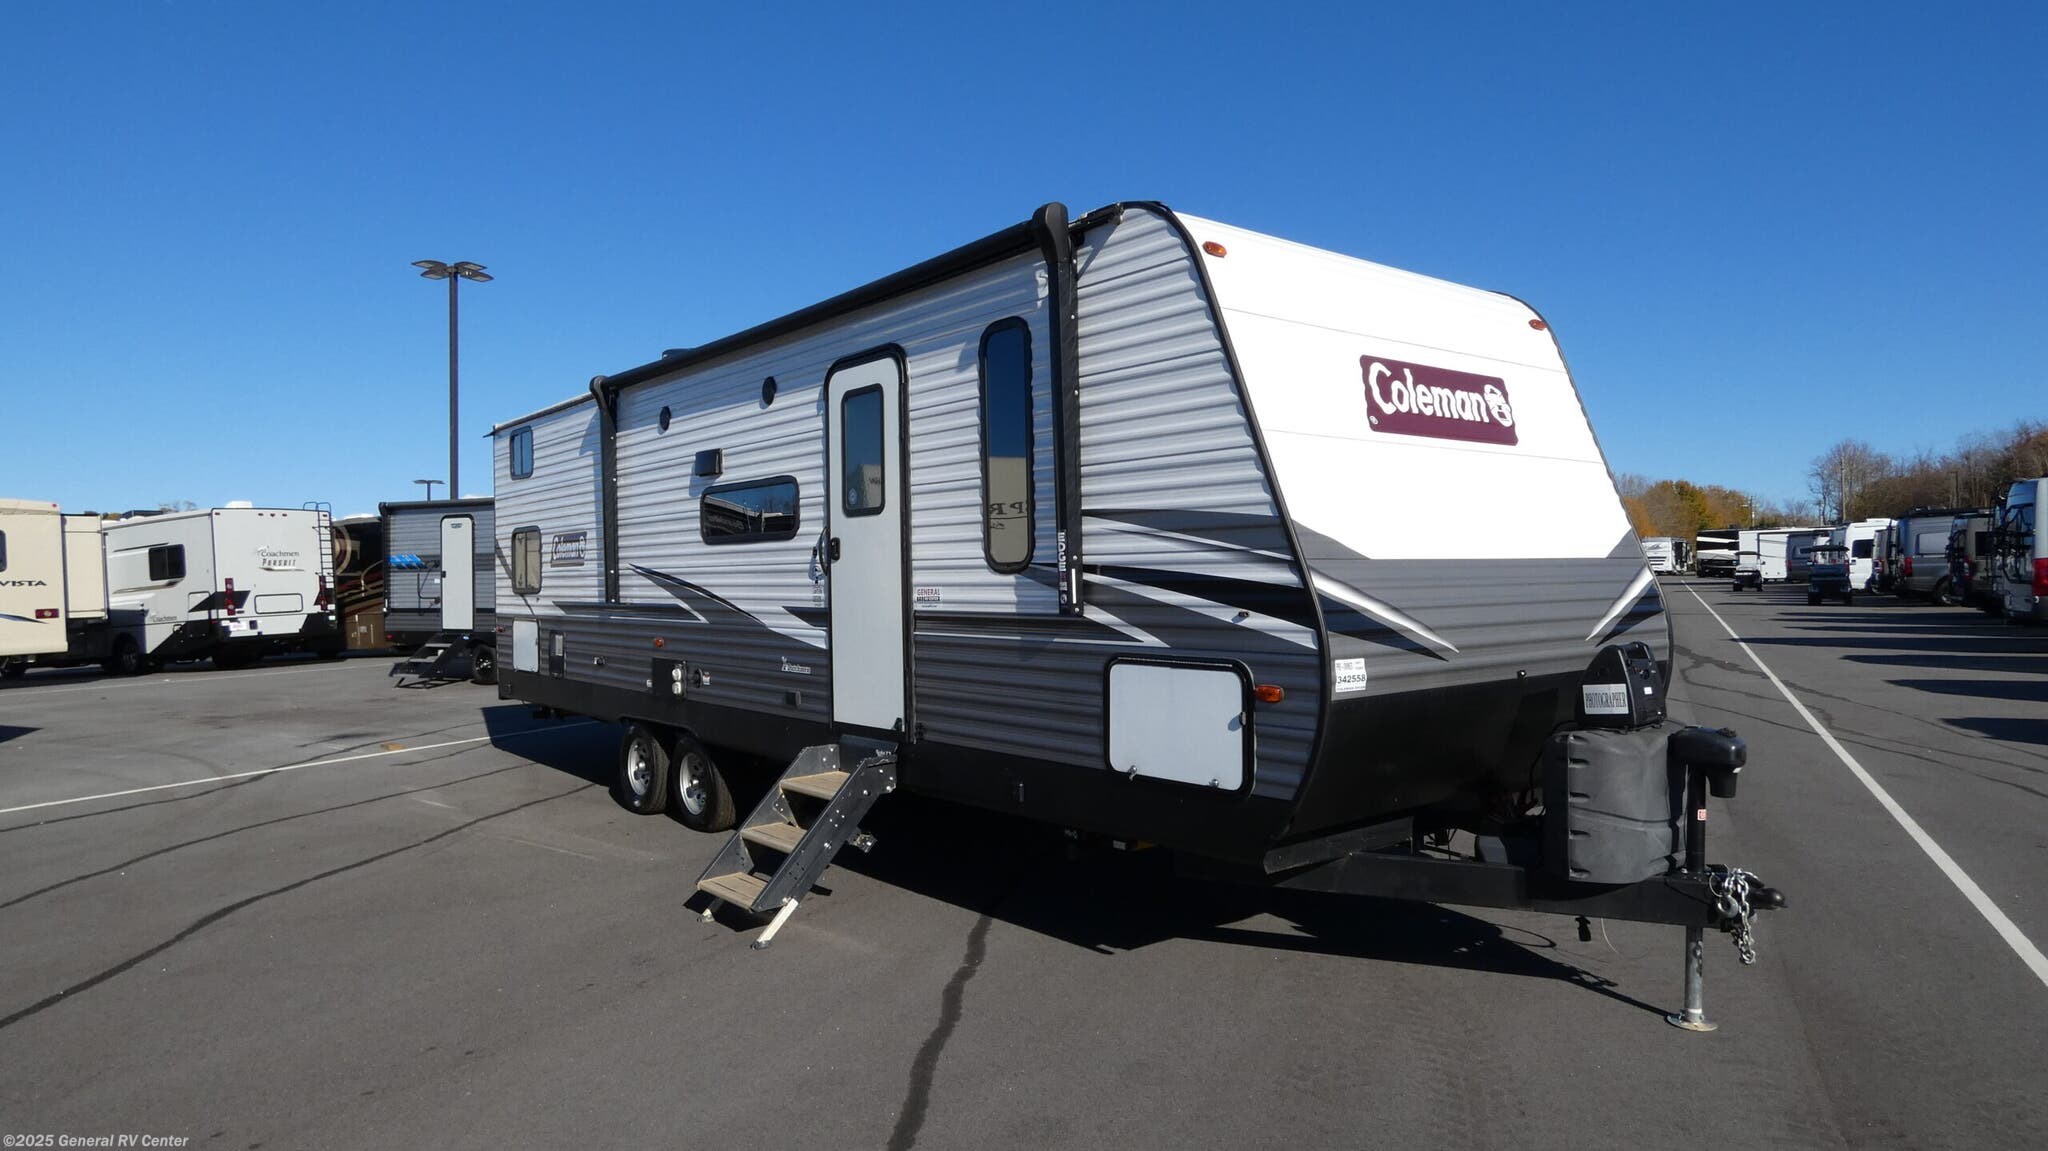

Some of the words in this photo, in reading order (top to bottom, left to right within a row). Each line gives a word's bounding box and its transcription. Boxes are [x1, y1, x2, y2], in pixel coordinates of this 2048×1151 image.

[1368, 361, 1490, 423] Coleman
[917, 588, 941, 596] GENERAL
[1337, 673, 1366, 685] 342558
[1585, 691, 1627, 709] PHOTOGRAPHER
